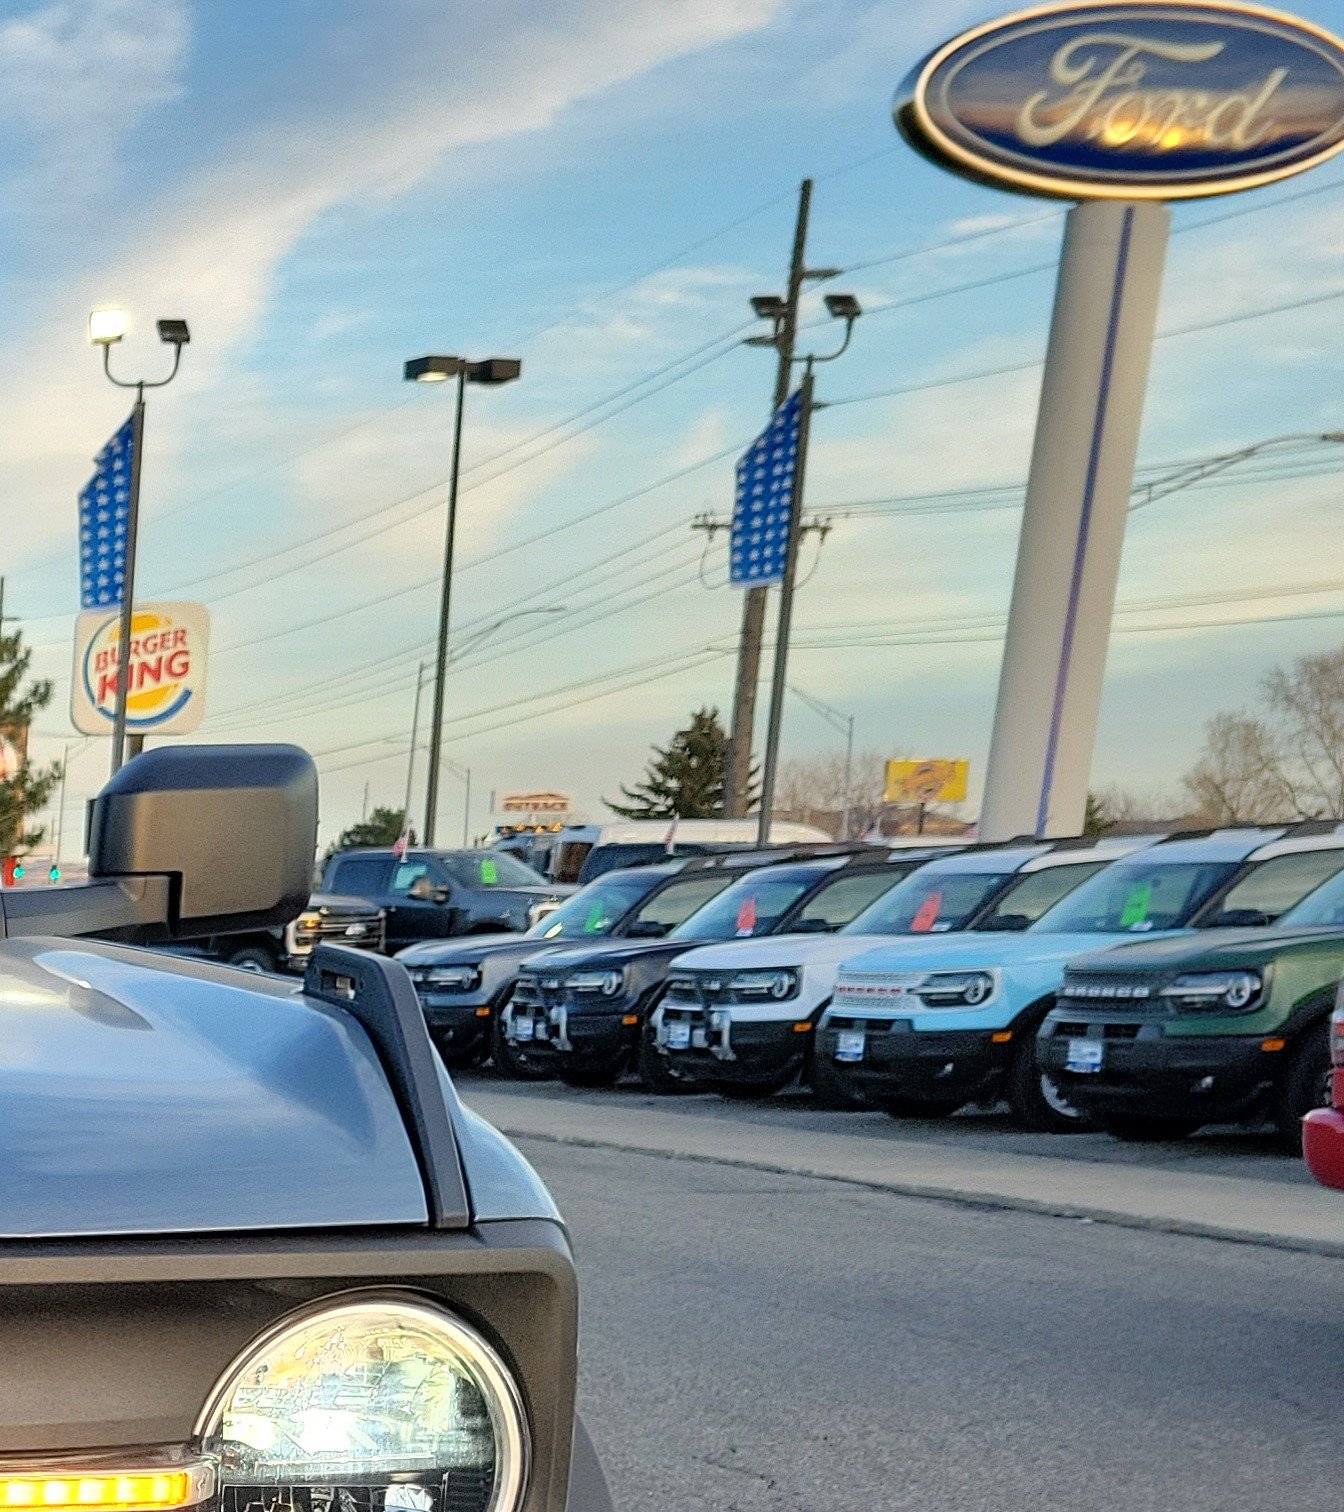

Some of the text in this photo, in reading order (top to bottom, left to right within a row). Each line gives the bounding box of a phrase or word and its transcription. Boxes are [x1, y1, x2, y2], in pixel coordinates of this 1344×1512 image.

[1018, 34, 1290, 150] Ford
[95, 629, 187, 673] BURGER
[98, 650, 190, 703] KING
